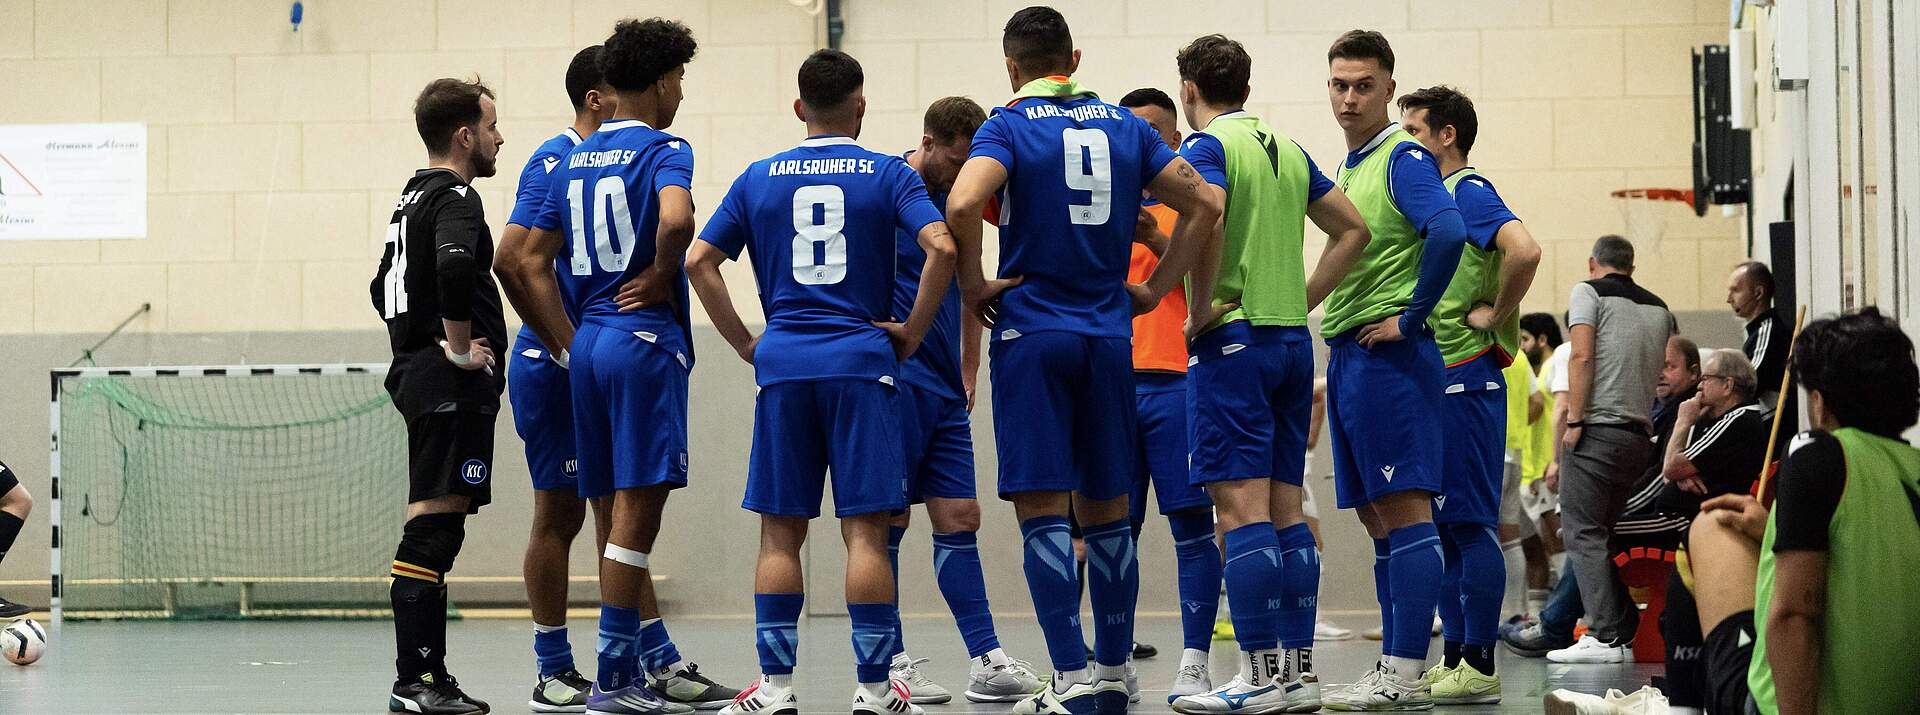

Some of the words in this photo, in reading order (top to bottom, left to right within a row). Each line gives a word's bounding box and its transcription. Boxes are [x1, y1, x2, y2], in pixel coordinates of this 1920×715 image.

[768, 158, 856, 176] KARLSRUHER
[858, 158, 875, 174] SC
[1062, 127, 1111, 226] 9
[566, 175, 636, 276] 10
[792, 184, 847, 286] 8
[466, 464, 483, 478] KSC
[1106, 611, 1128, 625] KSC
